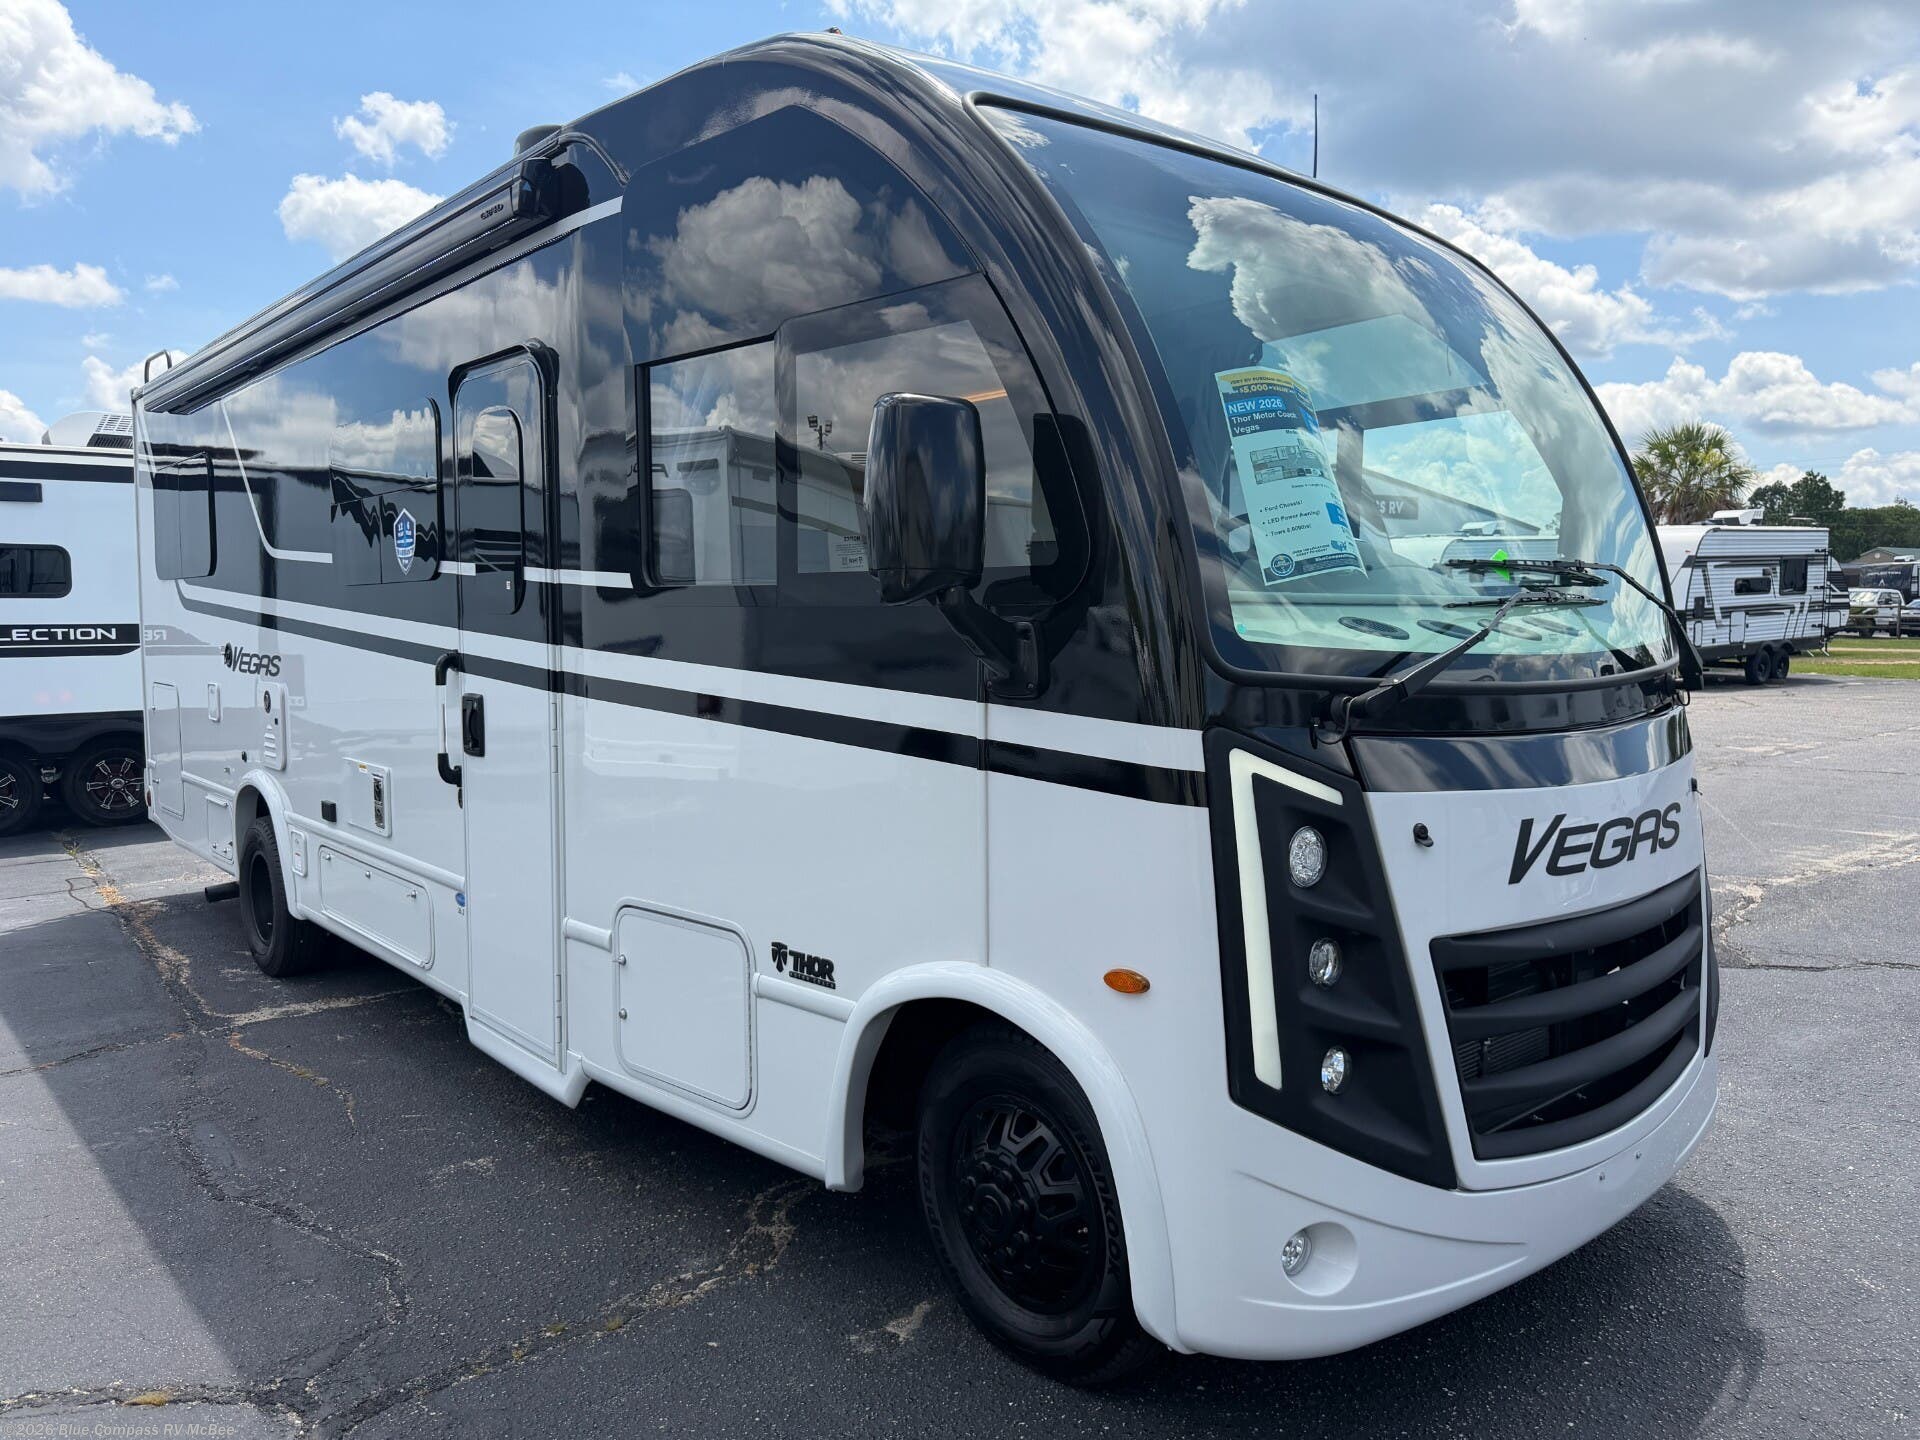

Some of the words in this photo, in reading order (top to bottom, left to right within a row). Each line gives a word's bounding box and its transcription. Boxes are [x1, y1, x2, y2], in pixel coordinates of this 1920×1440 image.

[1228, 401, 1256, 414] NEW
[1259, 398, 1283, 408] 2026
[1231, 415, 1252, 424] Thor
[1253, 412, 1276, 421] Motor
[1233, 424, 1260, 434] Vegas
[1389, 500, 1404, 514] RV
[232, 646, 281, 677] VEGAS
[1508, 802, 1681, 885] VEGAS
[788, 949, 836, 983] THOR
